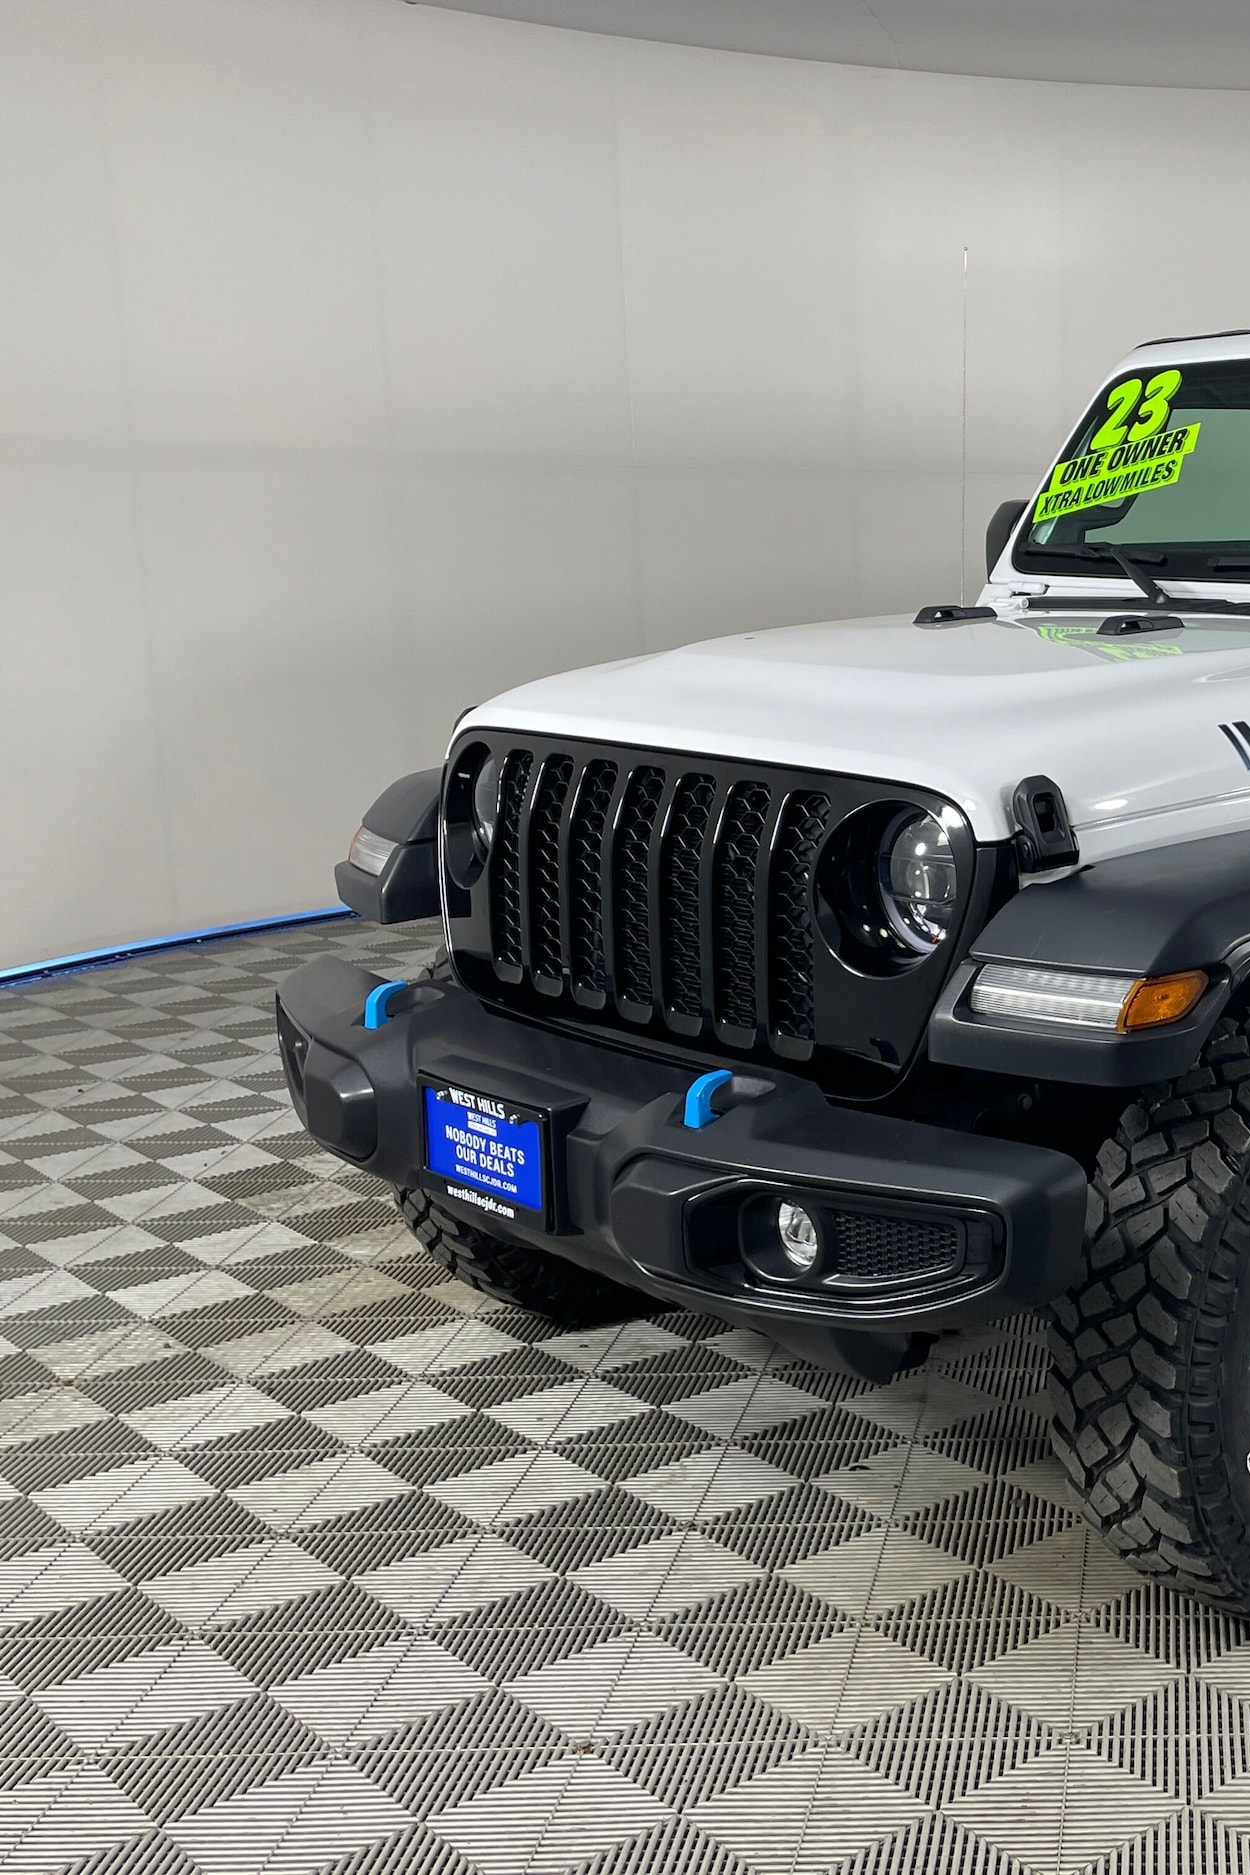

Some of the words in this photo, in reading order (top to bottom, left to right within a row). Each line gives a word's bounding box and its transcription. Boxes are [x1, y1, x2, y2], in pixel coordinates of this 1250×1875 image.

[1090, 370, 1182, 450] 23
[1059, 450, 1105, 485] ONE
[1107, 428, 1190, 472] OWNER
[1039, 486, 1083, 516] XTRA
[1083, 476, 1123, 502] LOW
[1120, 459, 1177, 493] MILES
[449, 1087, 476, 1109] WEST
[477, 1097, 505, 1119] HILLS
[467, 1111, 482, 1123] WEST
[445, 1125, 487, 1152] NOBODY
[490, 1141, 525, 1165] BEATS
[456, 1144, 477, 1165] OUR
[479, 1154, 515, 1177] DEALS
[456, 1164, 517, 1193] WESTHILLSCJDR.COM
[447, 1185, 515, 1219] westhillscjdr.com
